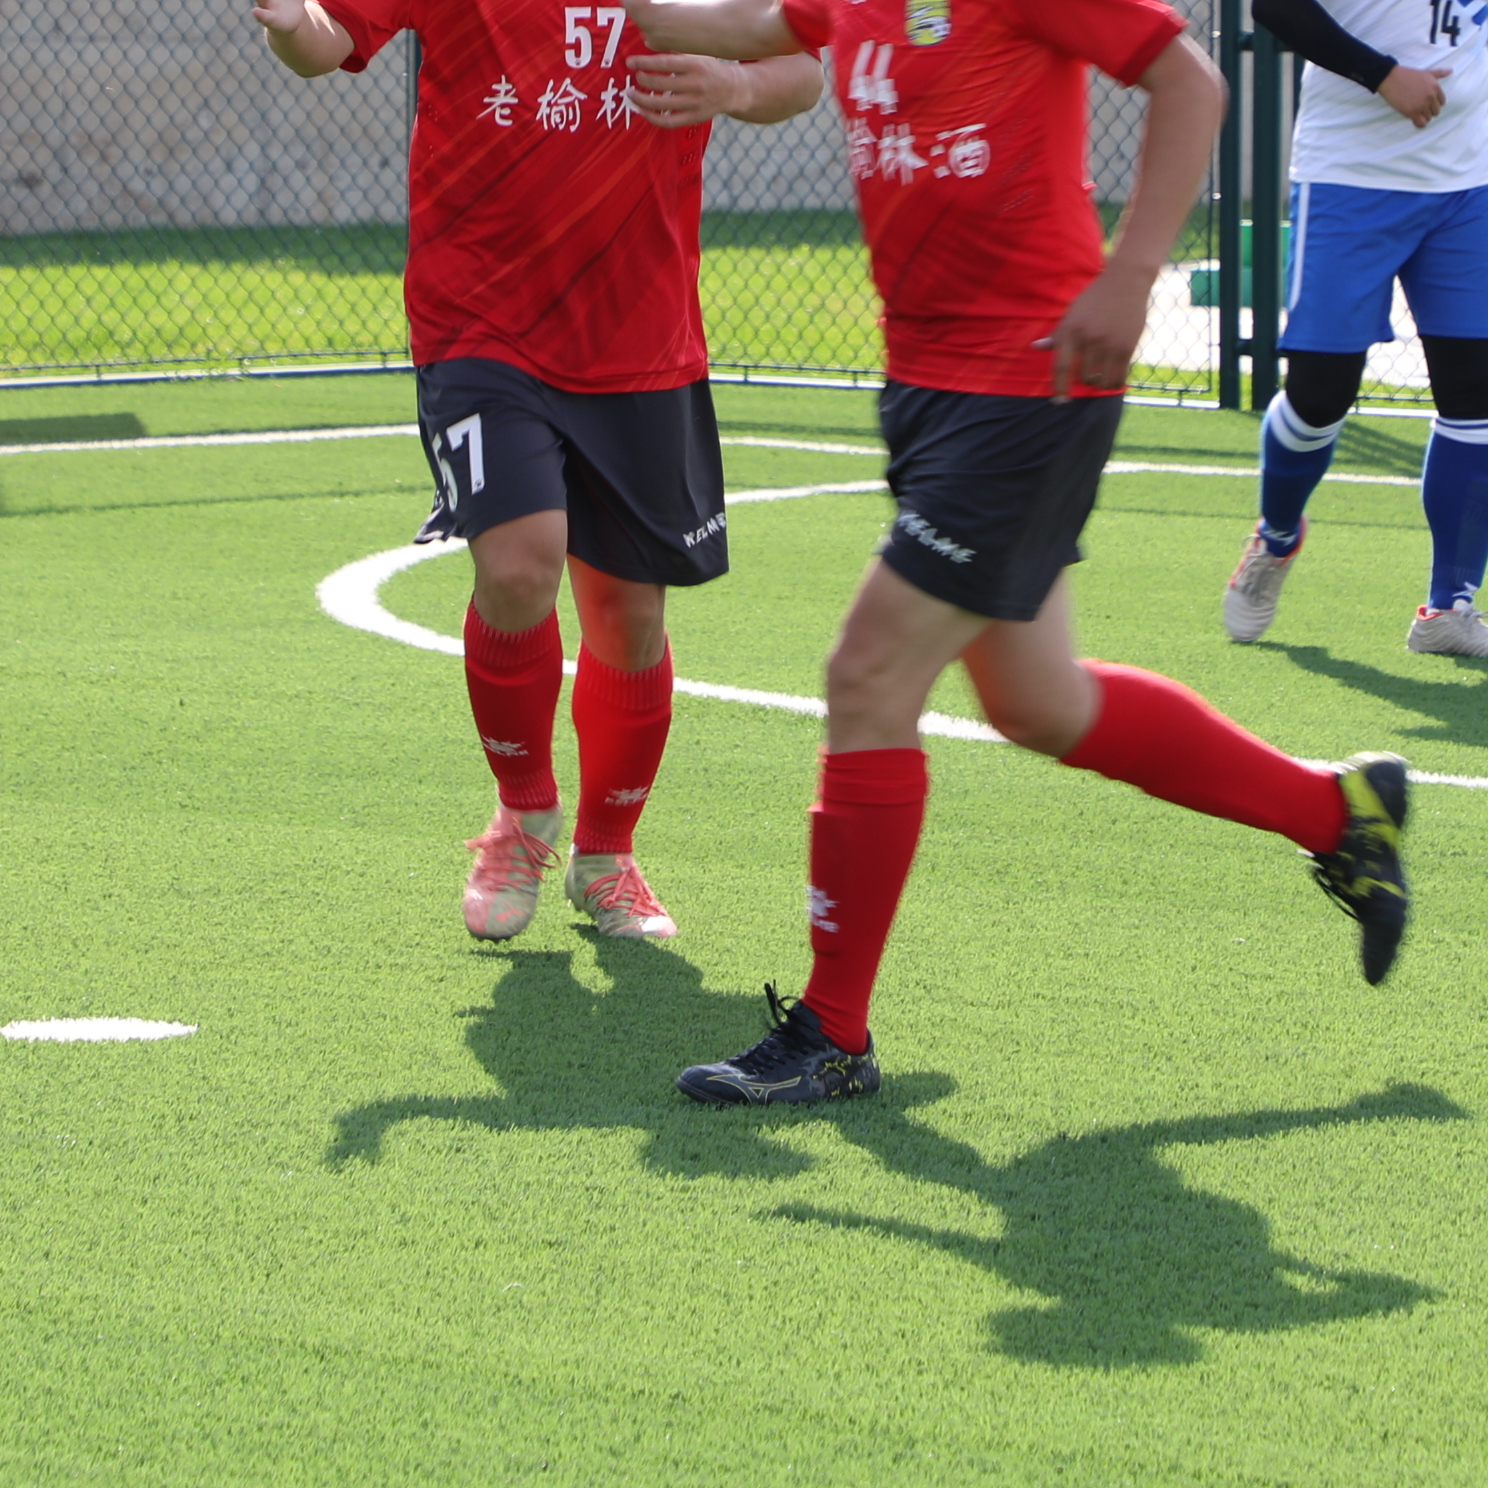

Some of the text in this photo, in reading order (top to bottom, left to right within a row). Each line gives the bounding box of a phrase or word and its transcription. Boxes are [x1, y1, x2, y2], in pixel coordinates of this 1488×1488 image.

[564, 5, 627, 70] 57
[475, 74, 676, 133] 老榆林
[847, 39, 899, 116] 44
[682, 512, 727, 549] KELME
